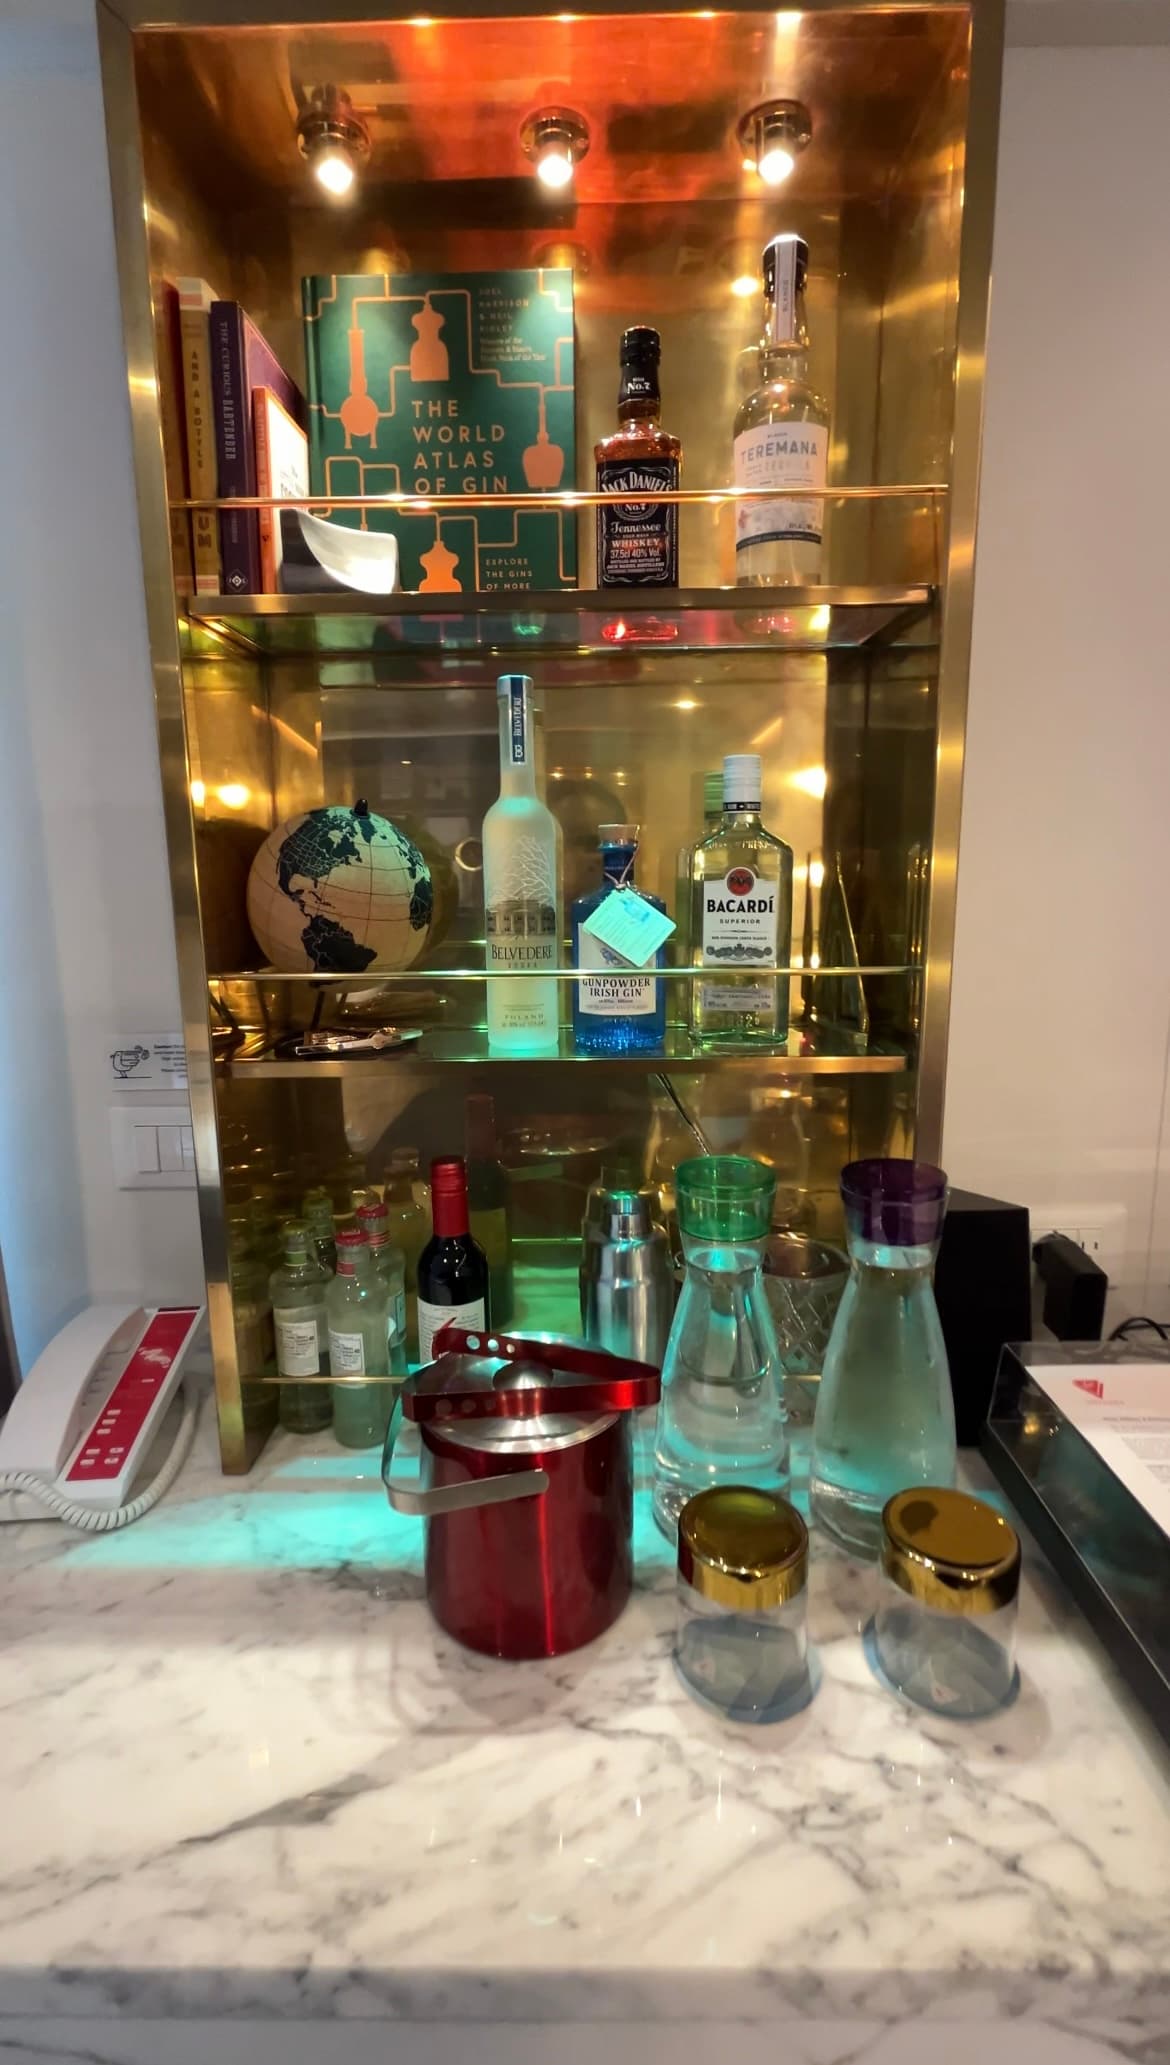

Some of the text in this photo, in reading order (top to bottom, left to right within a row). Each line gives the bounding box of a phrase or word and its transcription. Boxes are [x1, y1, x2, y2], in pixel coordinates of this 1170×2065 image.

[411, 400, 458, 418] THE
[223, 400, 237, 460] BARTENDER
[412, 425, 505, 443] WORLD
[413, 451, 495, 469] ATLAS
[741, 440, 818, 465] TEREMANA
[414, 476, 508, 495] OF GIN
[601, 471, 673, 492] JACK DANIEL'S
[610, 521, 661, 534] Tennessee
[611, 538, 660, 549] WHISKEY
[485, 558, 529, 566] EXPLORE
[486, 570, 533, 578] THE GINS
[486, 582, 531, 591] OF MORE
[706, 895, 775, 913] BACARDÍ
[491, 944, 553, 960] BELVEDERE
[582, 977, 651, 988] GUNPOWDER
[589, 987, 642, 998] IRISH GIN
